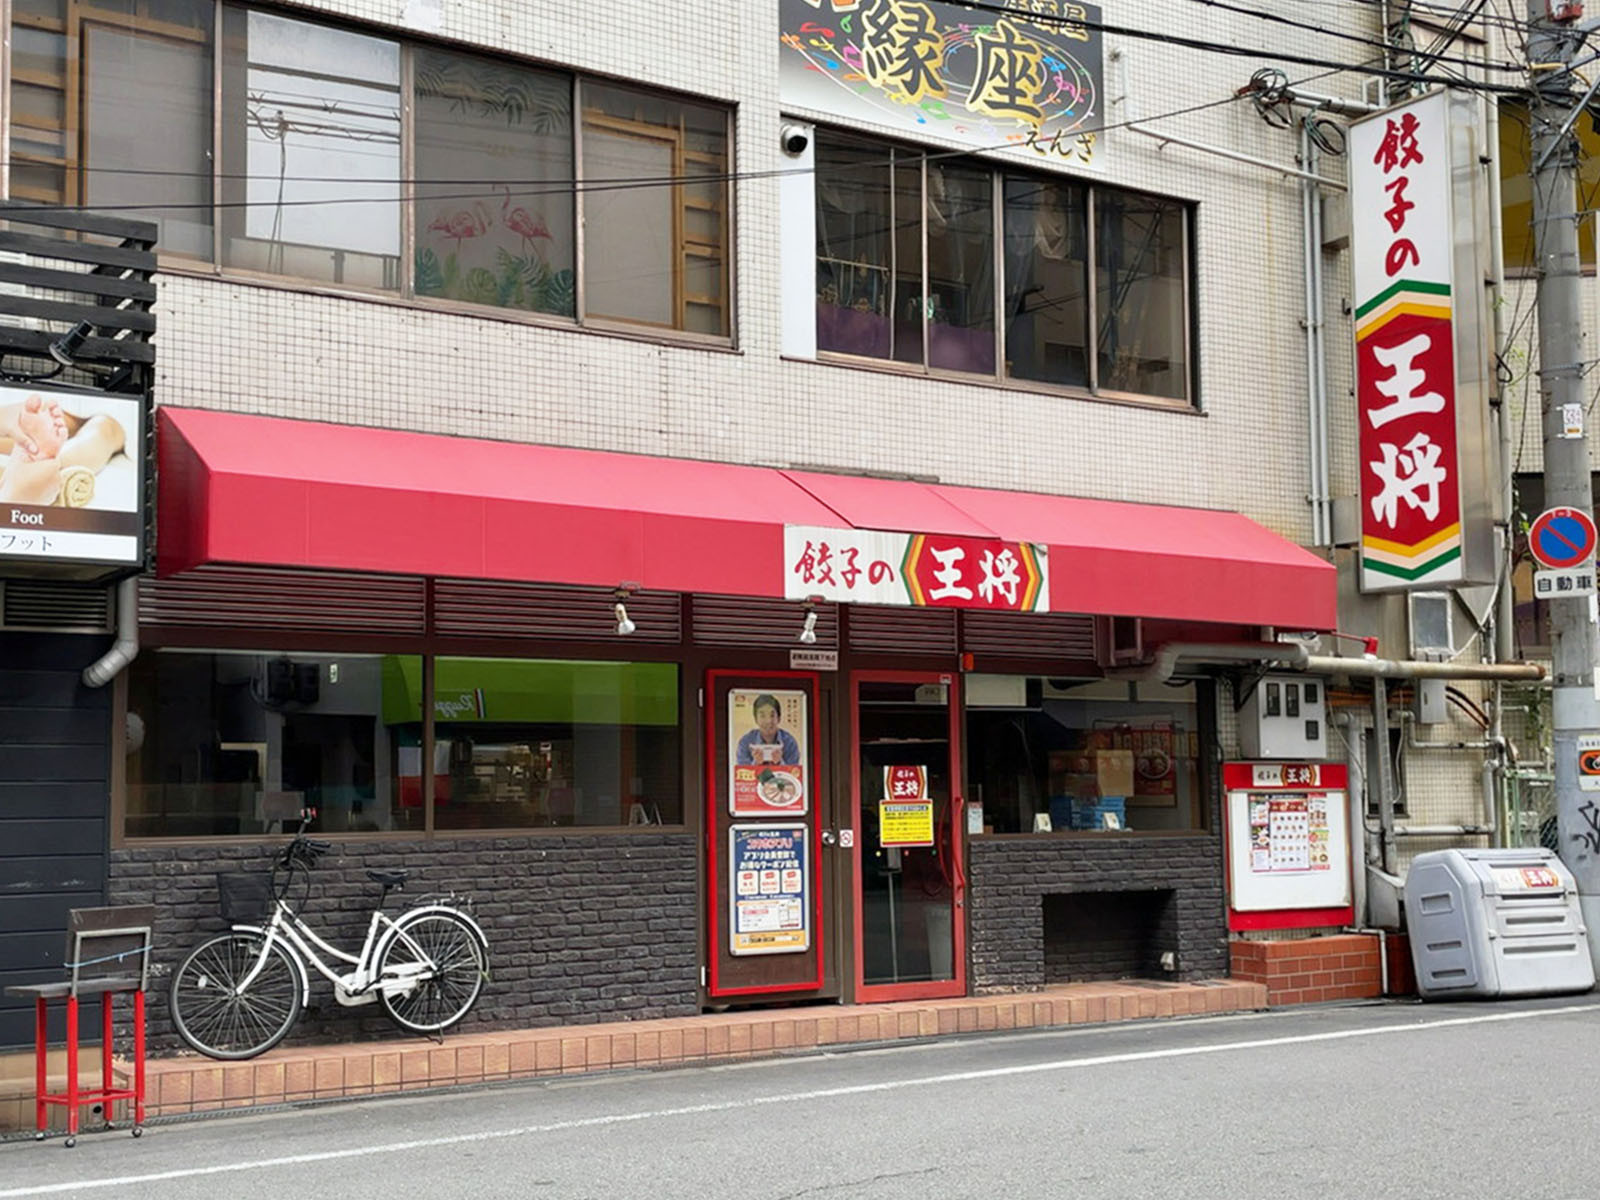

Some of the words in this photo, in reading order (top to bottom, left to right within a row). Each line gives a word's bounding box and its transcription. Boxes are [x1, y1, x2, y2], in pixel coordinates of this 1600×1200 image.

[1024, 123, 1096, 163] えんざ
[1367, 113, 1446, 529] 餃子の王将
[11, 509, 44, 525] Foot
[1, 535, 53, 552] フット
[794, 540, 1020, 605] 餃子の王将
[1537, 575, 1592, 592] 自動車
[893, 780, 919, 796] 王将
